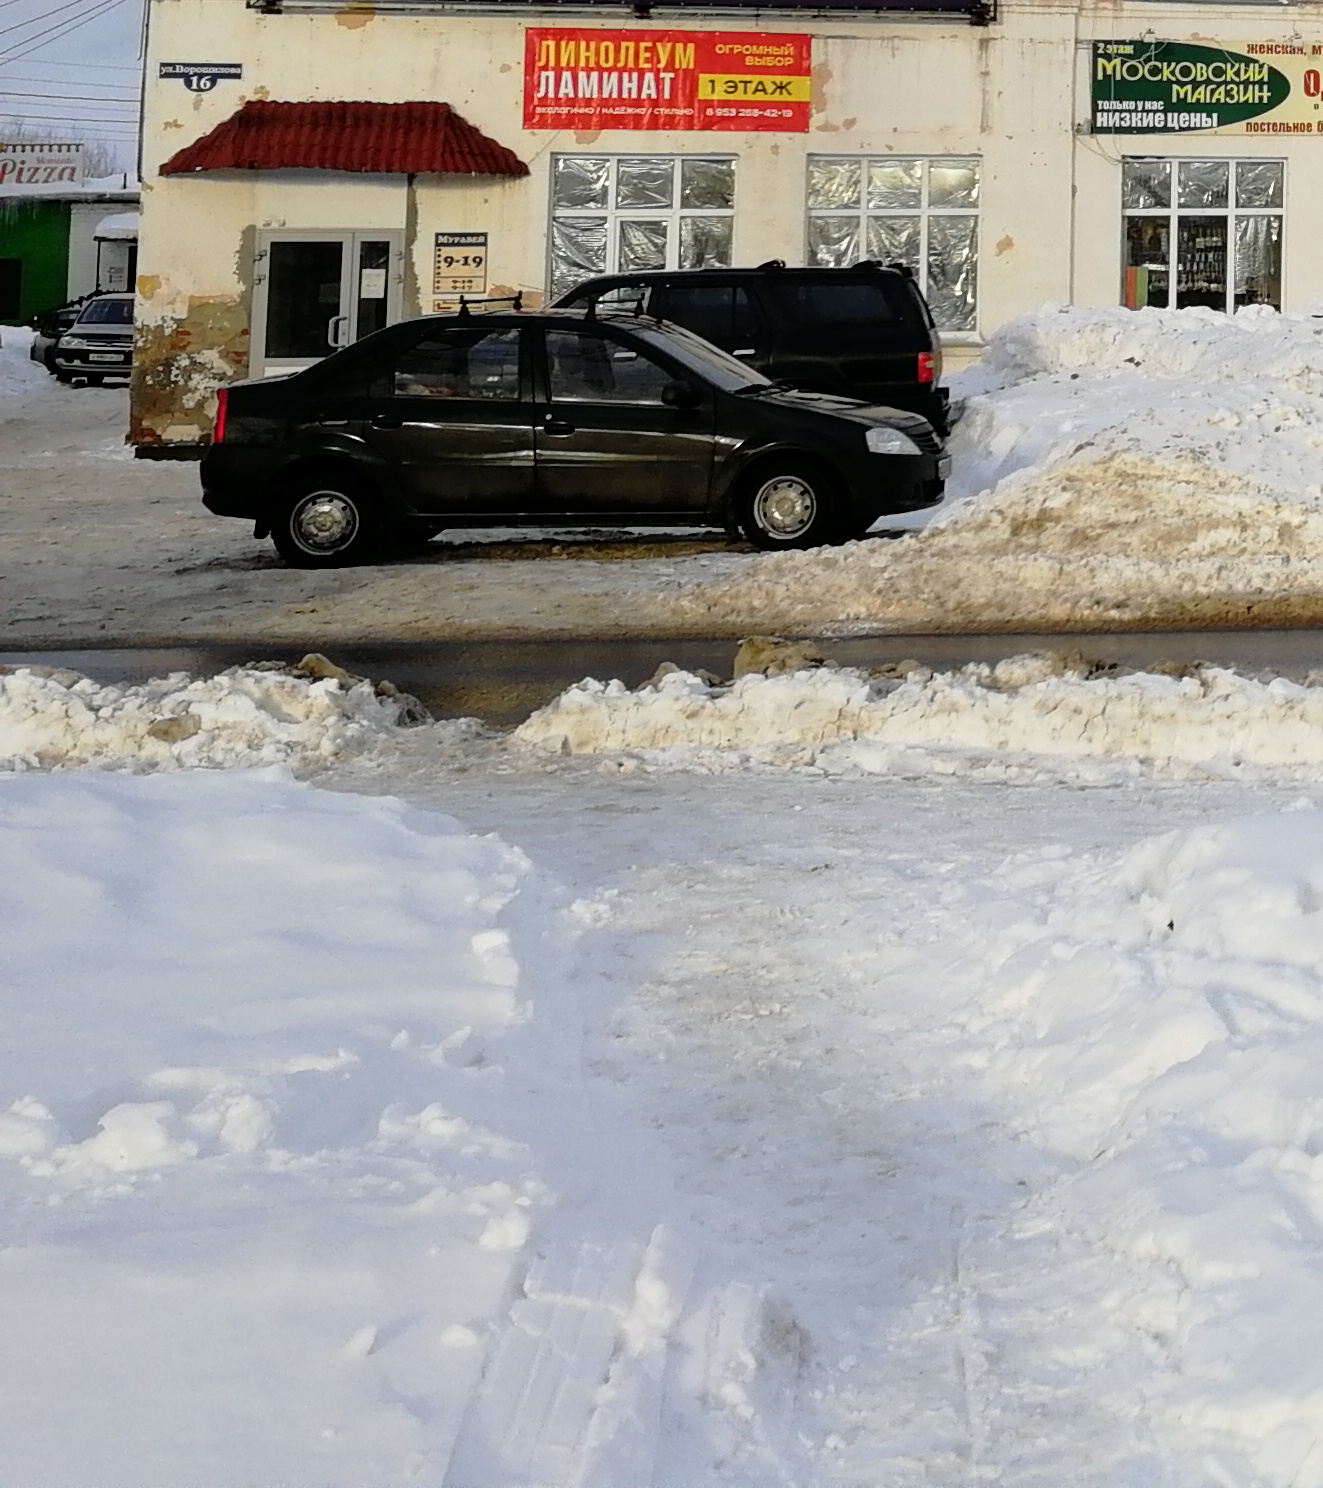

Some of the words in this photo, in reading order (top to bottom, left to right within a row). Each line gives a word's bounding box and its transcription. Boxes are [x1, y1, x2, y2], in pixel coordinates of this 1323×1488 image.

[537, 40, 696, 70] ЛИНОЛЕУМ
[715, 43, 794, 55] ОГРОМНЫЙ
[1097, 43, 1105, 54] 2
[1105, 44, 1134, 54] этаж
[1247, 43, 1307, 56] женская,
[745, 56, 794, 66] ВЫБОР
[190, 75, 212, 90] 16
[537, 71, 676, 100] ЛАМИНАТ
[708, 79, 716, 95] 1
[723, 79, 794, 96] ЭТАЖ
[1171, 83, 1271, 103] МАГАЗИН
[705, 107, 714, 117] 8
[1097, 100, 1137, 110] только
[1137, 101, 1144, 111] у
[1145, 100, 1164, 110] нас
[1096, 113, 1167, 128] низкие
[1167, 113, 1218, 130] цены
[1246, 121, 1313, 133] постельное
[0, 159, 78, 184] Pizza
[443, 256, 484, 268] 9-19
